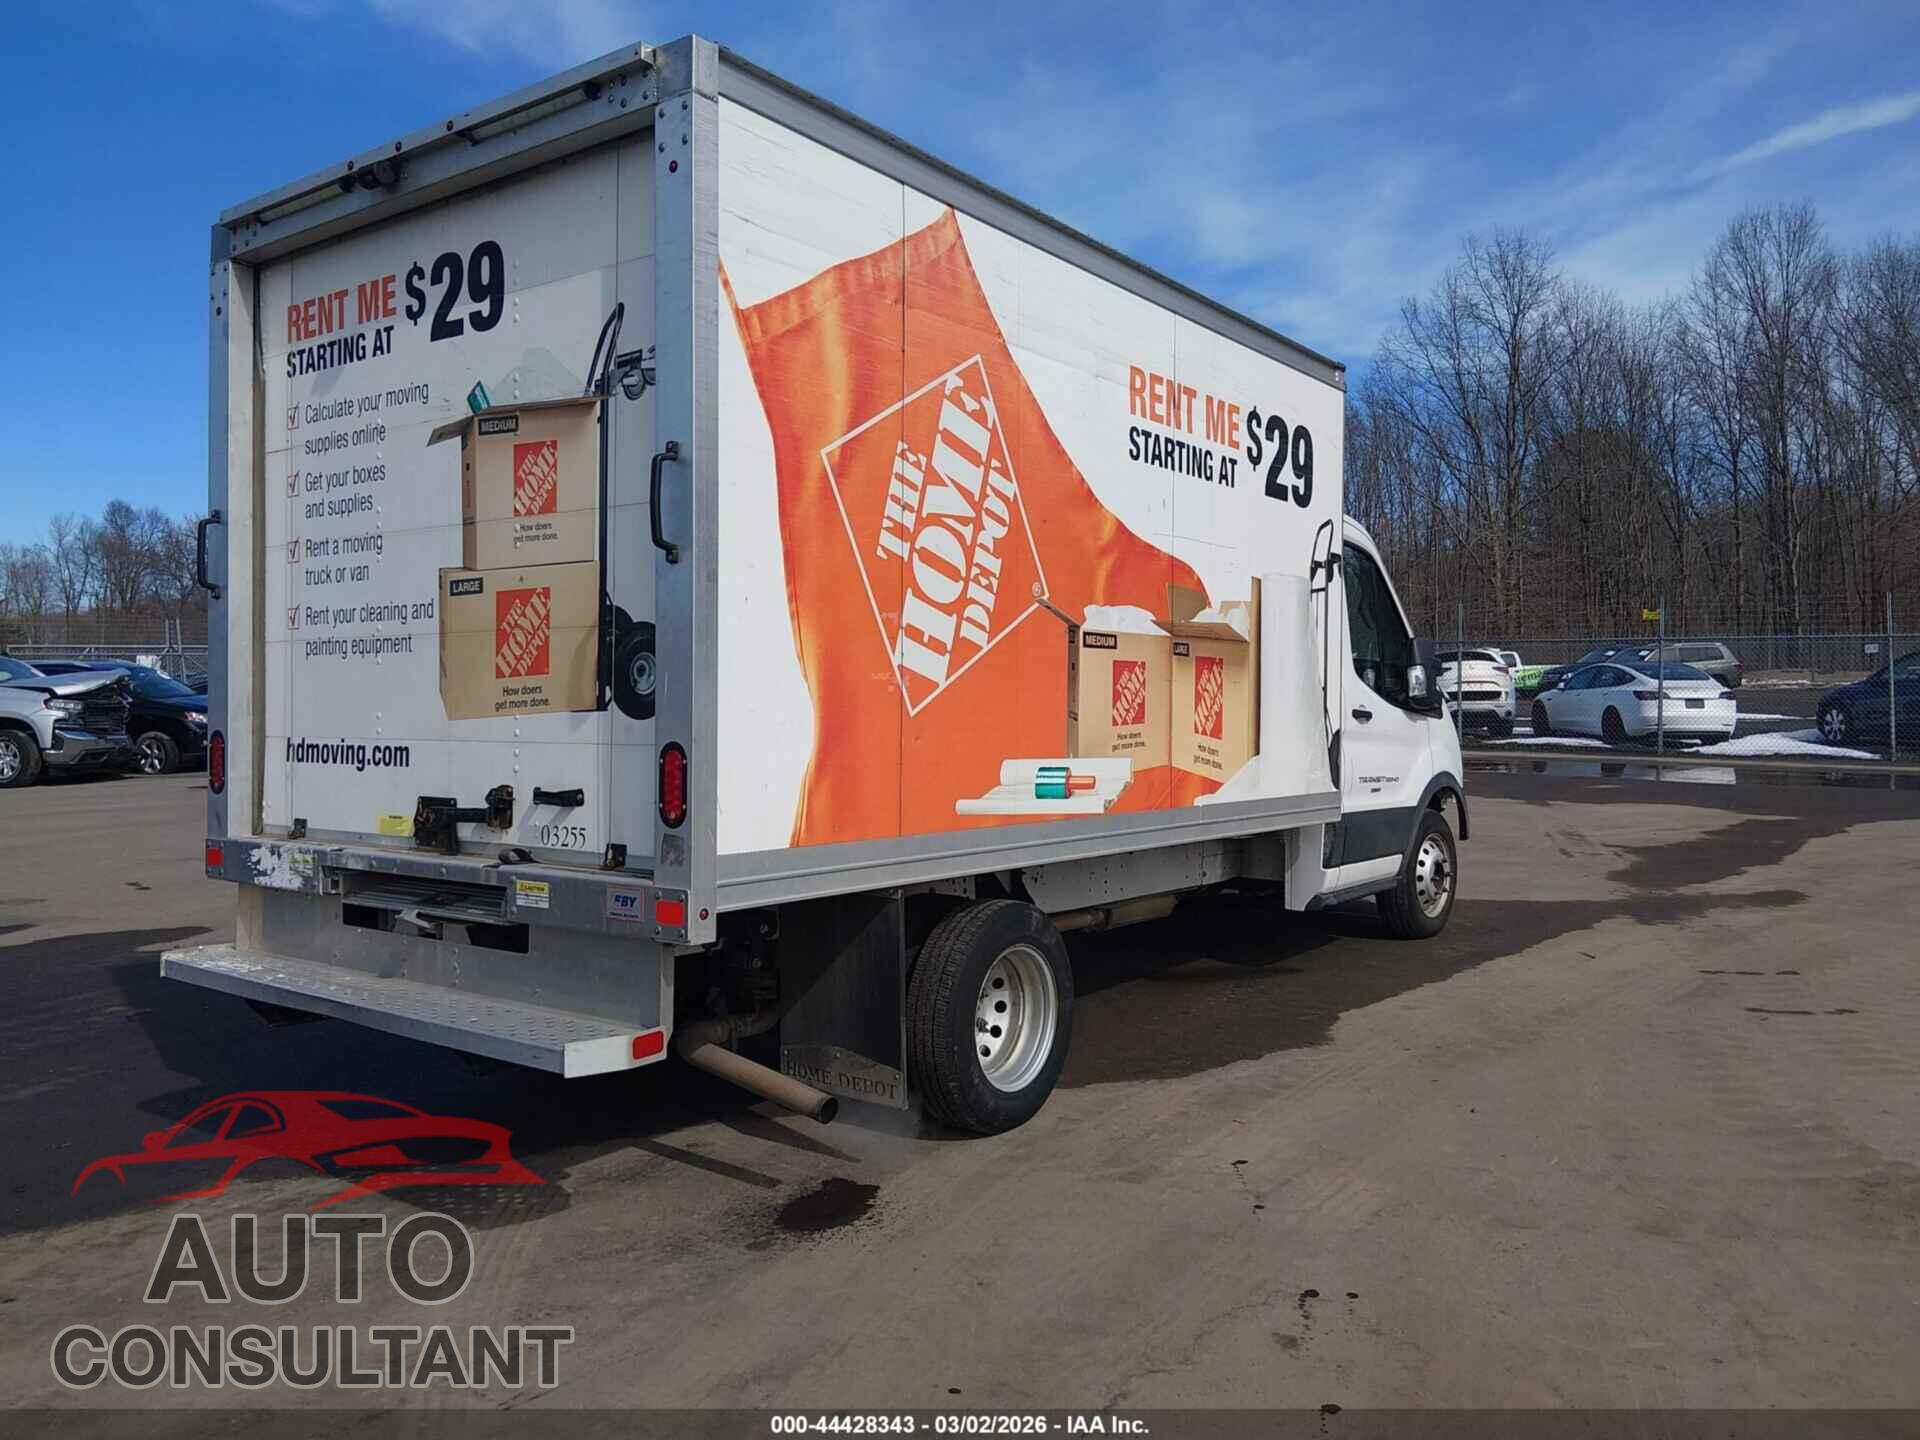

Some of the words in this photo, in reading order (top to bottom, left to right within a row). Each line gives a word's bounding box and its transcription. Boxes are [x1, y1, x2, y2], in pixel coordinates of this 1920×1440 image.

[287, 288, 348, 344] RENT
[357, 274, 397, 325] ME
[405, 240, 505, 343] $29
[286, 333, 366, 378] STARTING
[372, 325, 394, 357] AT
[305, 397, 354, 424] Calculate
[354, 393, 382, 418] your
[386, 382, 429, 407] moving
[1129, 365, 1197, 434] RENT
[1205, 394, 1240, 450] ME
[305, 430, 348, 455] supplies
[352, 424, 386, 446] online
[480, 418, 517, 433] MEDIUM
[1129, 426, 1213, 482] STARTING
[1218, 455, 1238, 488] AT
[1246, 405, 1314, 508] $29
[305, 471, 322, 492] Get
[326, 470, 350, 493] your
[352, 464, 385, 485] boxes
[514, 441, 557, 515] HOME
[305, 498, 324, 519] and
[327, 493, 373, 518] supplies
[876, 440, 927, 562] THE
[305, 538, 329, 558] Rent
[332, 539, 339, 556] a
[342, 532, 383, 555] moving
[520, 523, 533, 532] How
[894, 372, 995, 688] HOME
[960, 457, 1017, 649] DEPOT
[305, 565, 332, 585] truck
[335, 567, 347, 583] or
[350, 564, 369, 582] van
[452, 580, 481, 593] LARGE
[305, 606, 329, 626] Rent
[332, 607, 356, 628] your
[359, 601, 408, 624] cleaning
[411, 598, 434, 619] and
[501, 599, 525, 635] THE
[305, 636, 347, 660] painting
[351, 633, 413, 658] equipment
[496, 588, 551, 678] HOME
[516, 620, 551, 676] DEPOT
[1085, 634, 1116, 647] MEDIUM
[494, 700, 507, 712] get
[508, 699, 528, 709] more
[502, 686, 519, 697] How
[521, 685, 543, 695] doers
[1112, 661, 1146, 726] HOME
[286, 737, 410, 772] hdmoving.com
[540, 824, 586, 848] 03255
[783, 1060, 832, 1085] HOME
[839, 1073, 897, 1099] DEPOT
